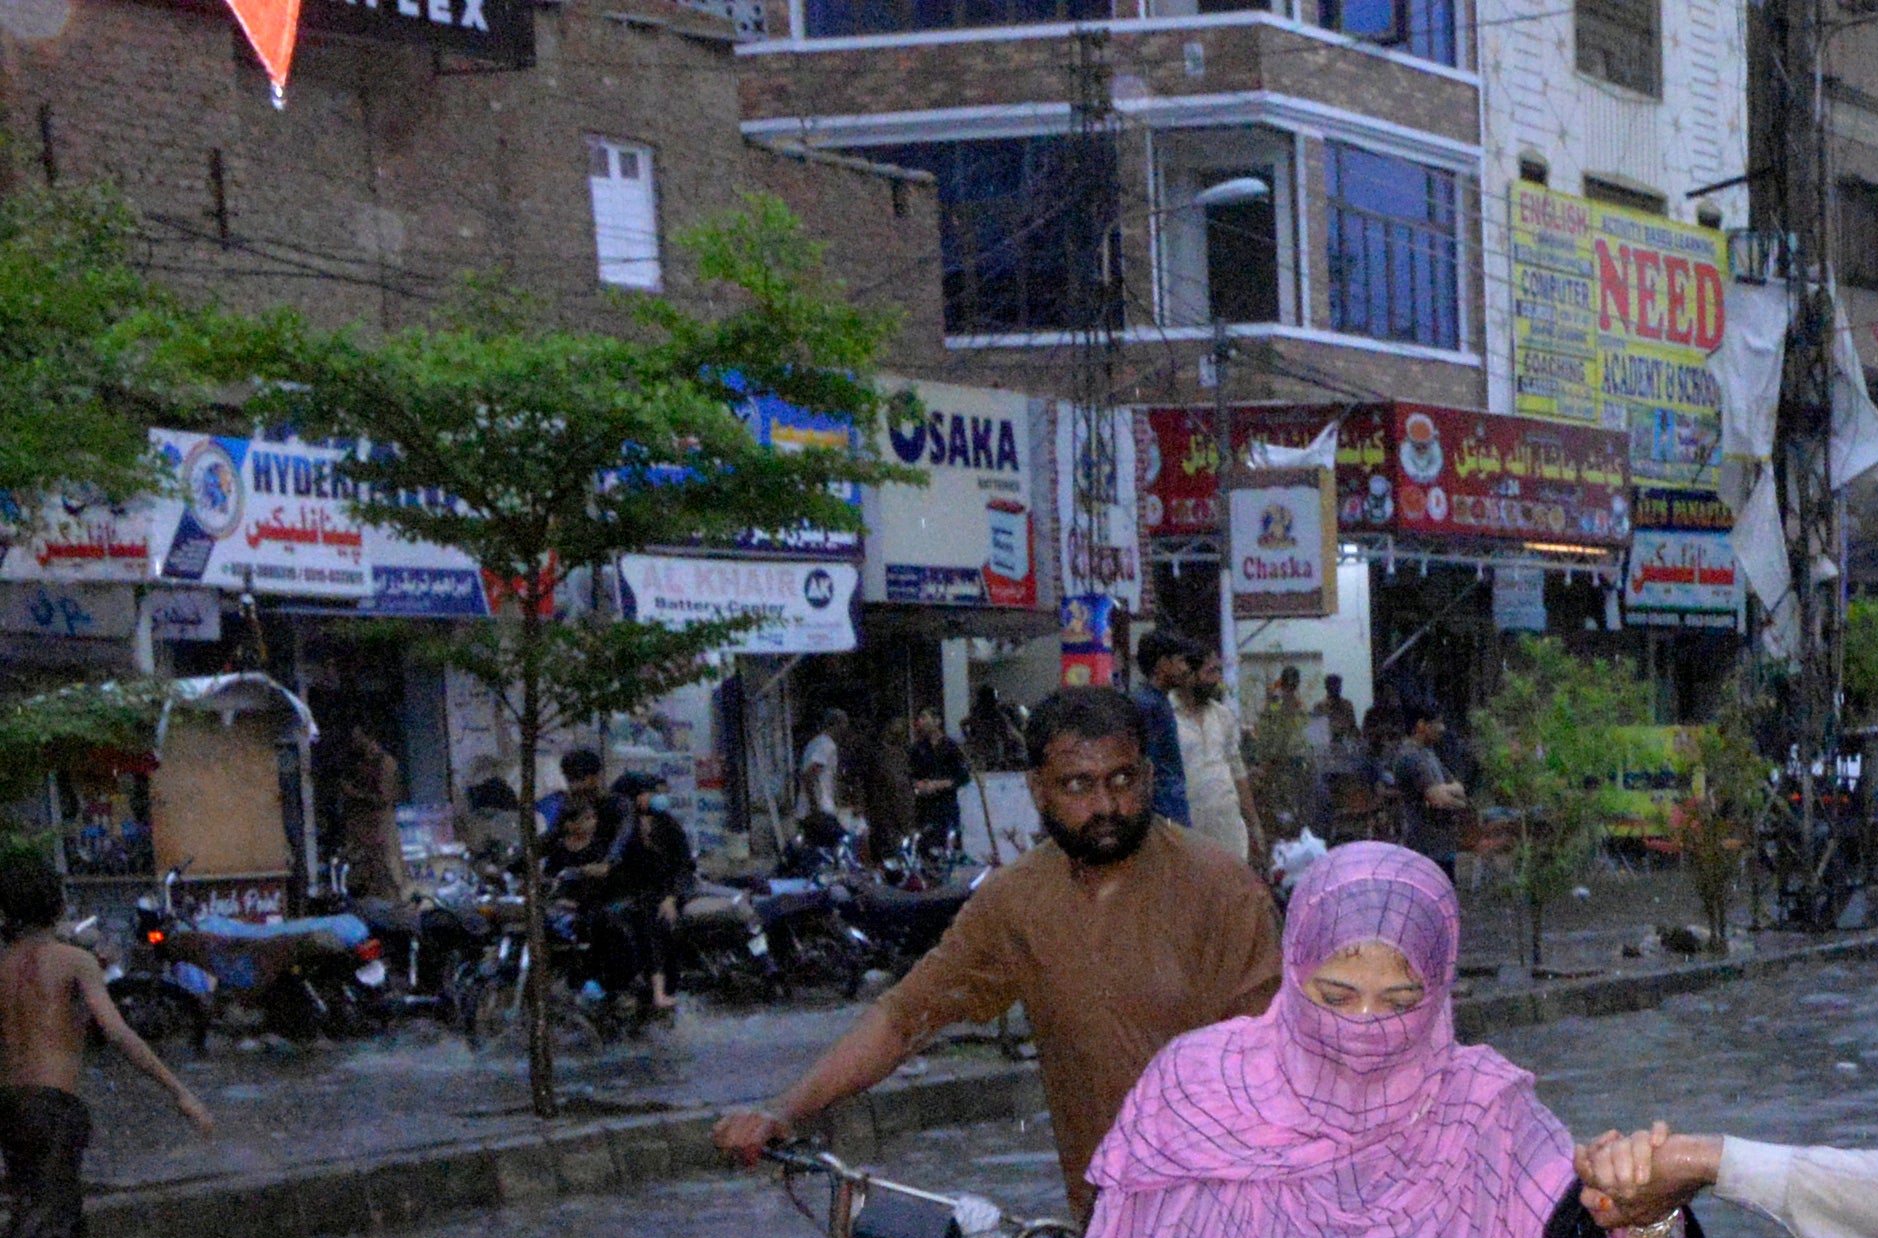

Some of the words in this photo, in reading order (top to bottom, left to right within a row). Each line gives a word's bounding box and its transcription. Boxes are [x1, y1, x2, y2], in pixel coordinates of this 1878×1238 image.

[1519, 189, 1589, 236] ENGLISH
[1521, 268, 1590, 312] COMPUTER
[1595, 238, 1725, 351] NEED
[1603, 350, 1662, 399] ACADEMY
[695, 564, 797, 599] KHAIR
[1243, 556, 1313, 580] Chaska
[655, 597, 726, 621] Battery
